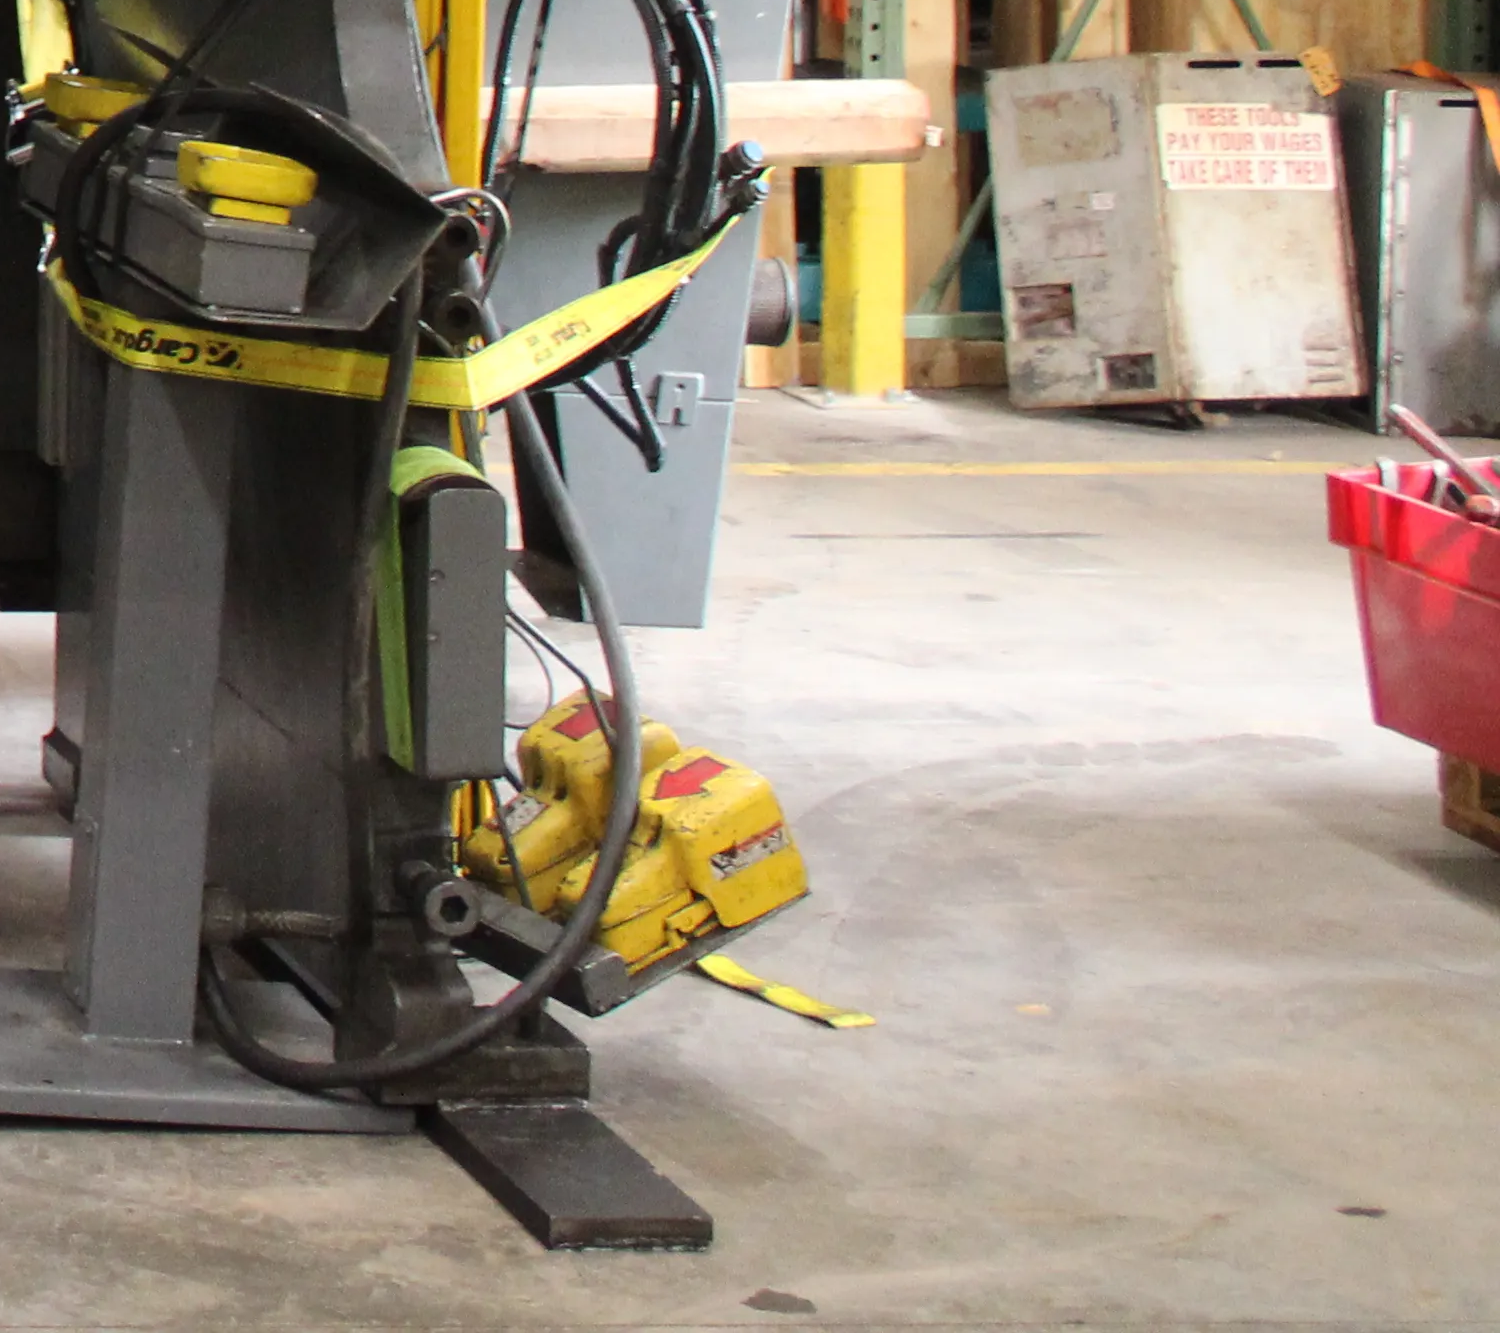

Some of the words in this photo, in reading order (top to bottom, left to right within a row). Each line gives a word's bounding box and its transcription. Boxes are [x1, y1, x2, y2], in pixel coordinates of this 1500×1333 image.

[1185, 107, 1239, 126] THESE
[1167, 132, 1200, 151] PAY
[1208, 132, 1254, 151] YOUR
[1260, 132, 1322, 151] WAGES
[1168, 160, 1207, 184] TAKE
[1212, 160, 1253, 184] CARE
[1257, 160, 1277, 184] OF
[1284, 160, 1327, 184] THEM
